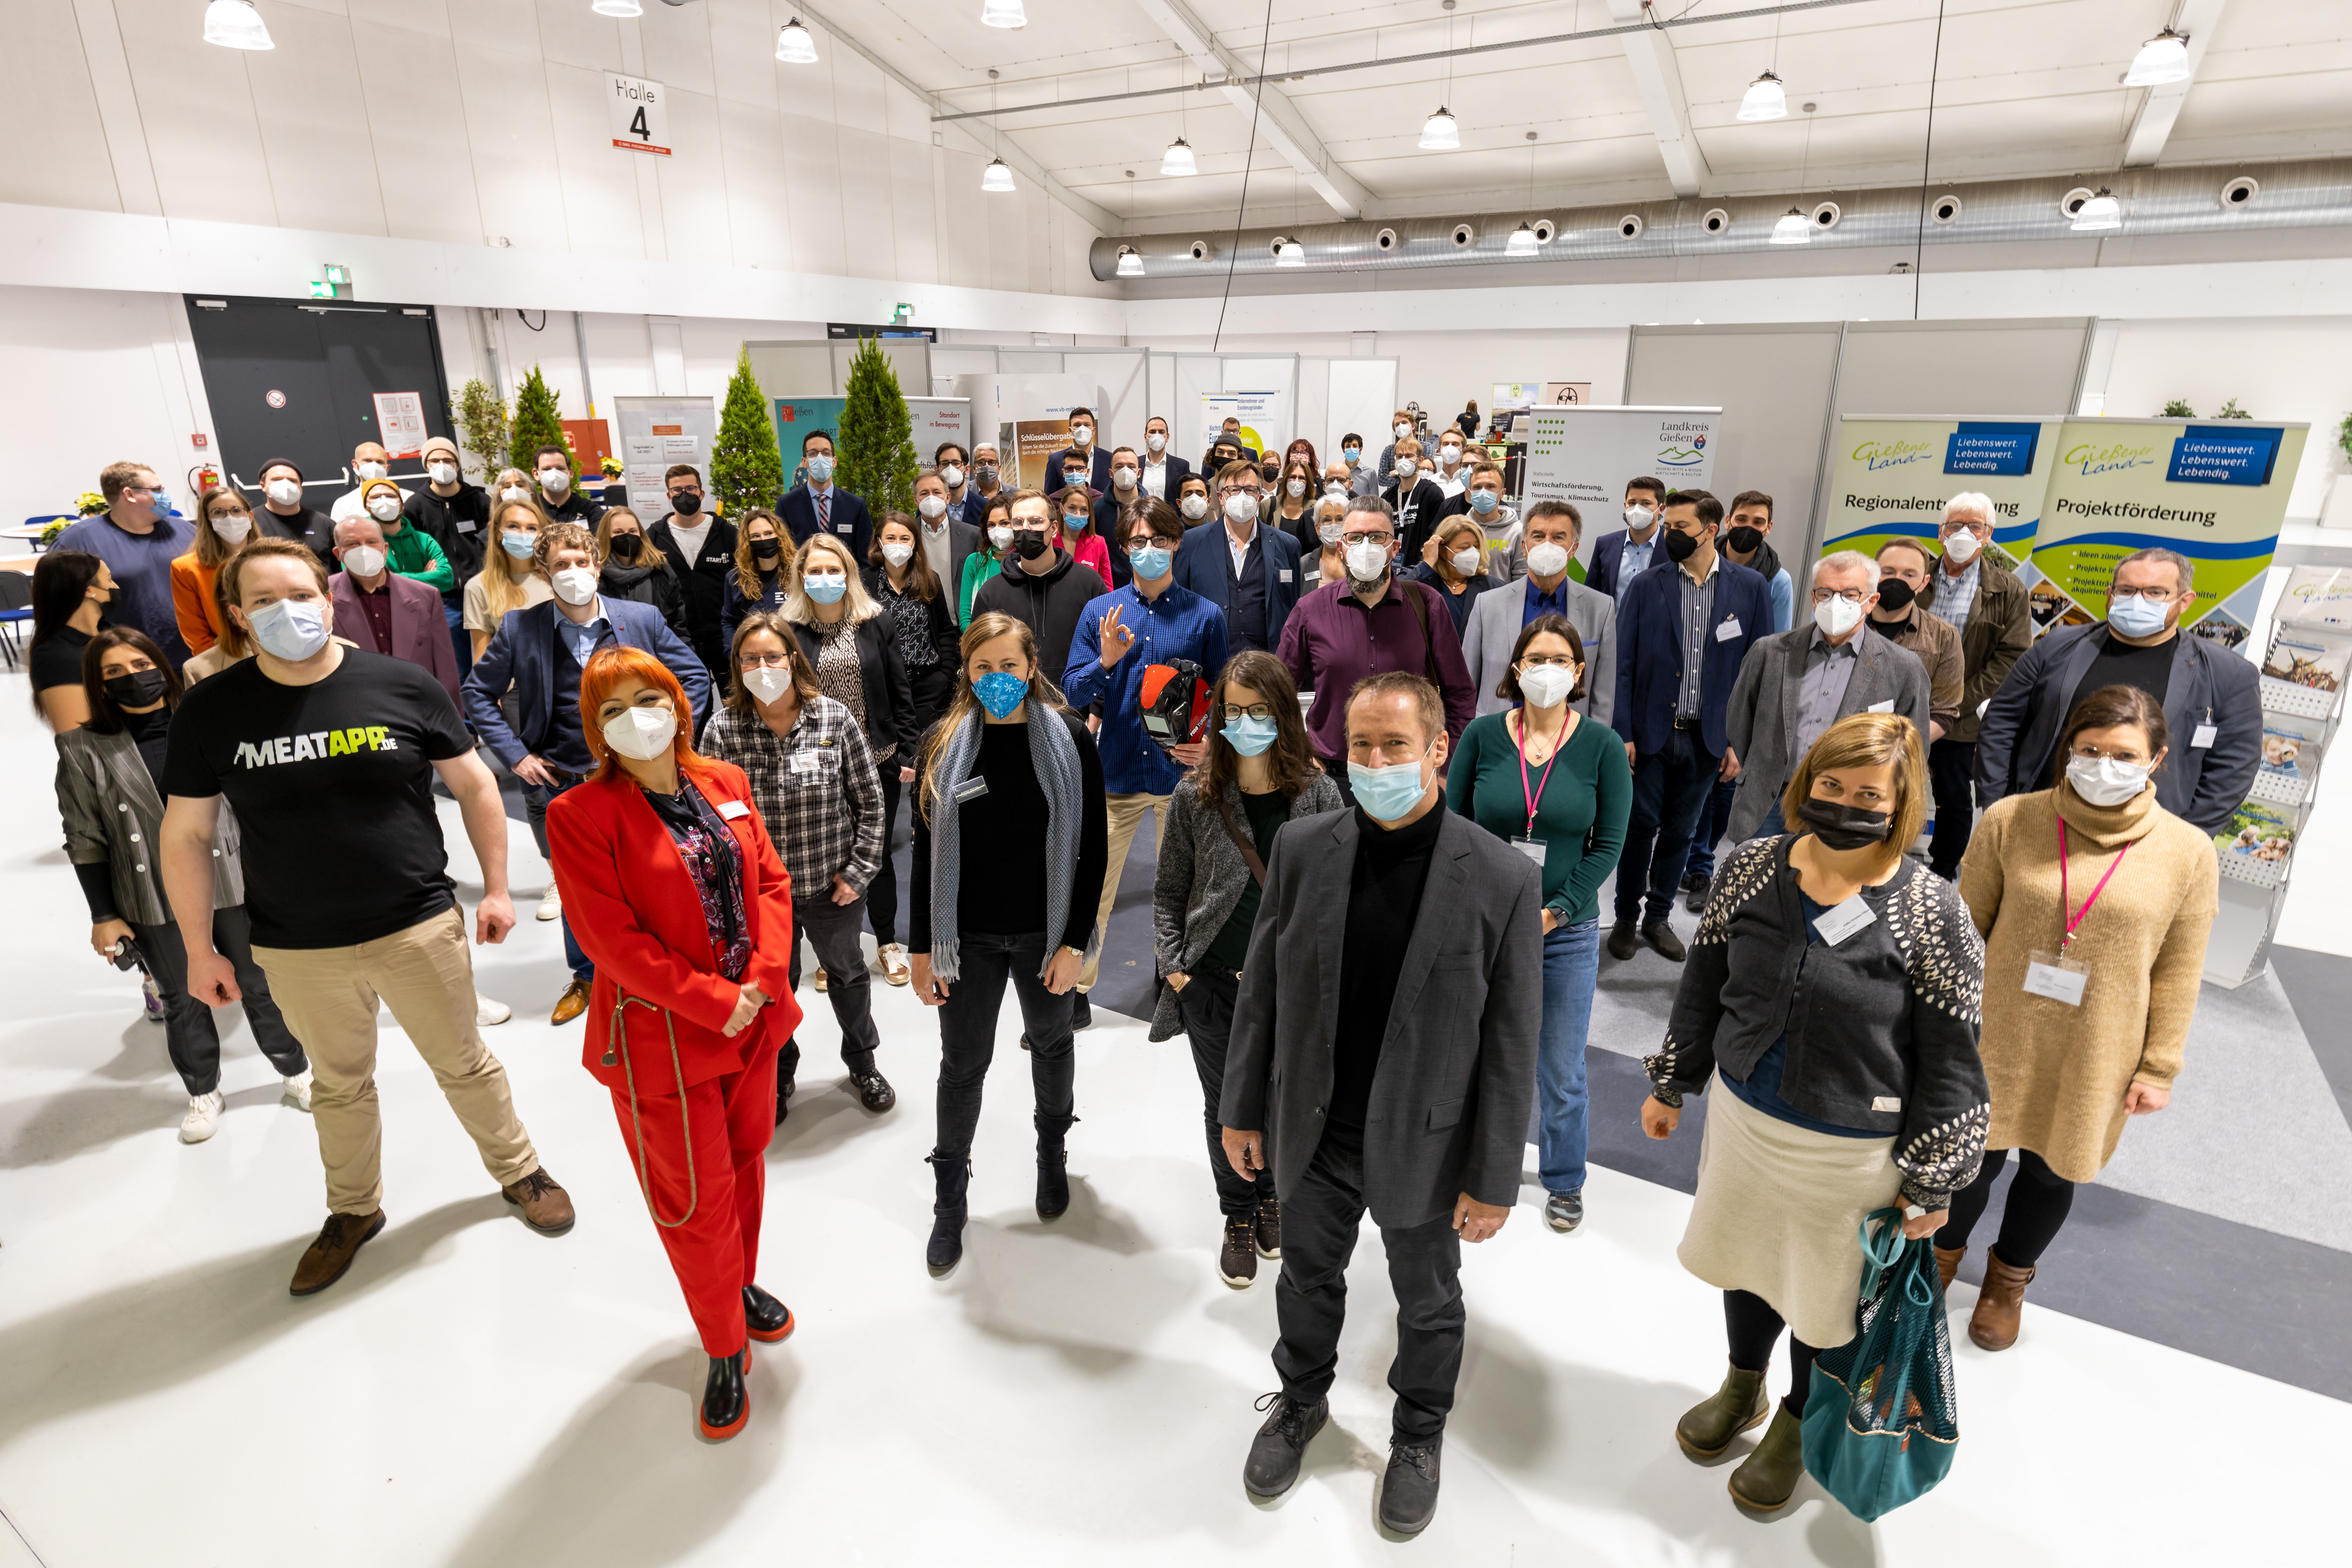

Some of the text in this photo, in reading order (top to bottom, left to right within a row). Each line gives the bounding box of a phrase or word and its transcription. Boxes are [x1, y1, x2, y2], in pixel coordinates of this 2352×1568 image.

[616, 79, 654, 102] Halle
[630, 106, 650, 141] 4
[786, 406, 813, 417] Gießen
[935, 421, 960, 429] Bewegung
[1662, 422, 1709, 432] Landkreis
[1660, 433, 1692, 442] Gießen
[1957, 438, 2018, 448] Liebenswert.
[1852, 440, 1932, 461] Gießener
[1956, 449, 2013, 459] Lebenswert.
[2064, 443, 2154, 465] Gießener
[2184, 443, 2255, 455] Liebenswert.
[1868, 451, 1932, 470] Land
[1953, 460, 1998, 471] Lebendig.
[2082, 456, 2154, 476] Land
[2181, 455, 2248, 467] Lebenswert.
[2178, 466, 2230, 480] Lebendig.
[1532, 481, 1603, 492] Wirtschaftsförderung,
[1531, 492, 1609, 503] Tourismus, Klimaschutz
[1845, 494, 2020, 517] Regionalentung
[2056, 499, 2217, 527] Projektförderung
[2079, 550, 2099, 559] Ideen
[2076, 563, 2106, 573] Projekte
[2073, 577, 2112, 587] Projektträ
[2071, 586, 2106, 596] akquiriere
[1197, 714, 1208, 727] TURBO
